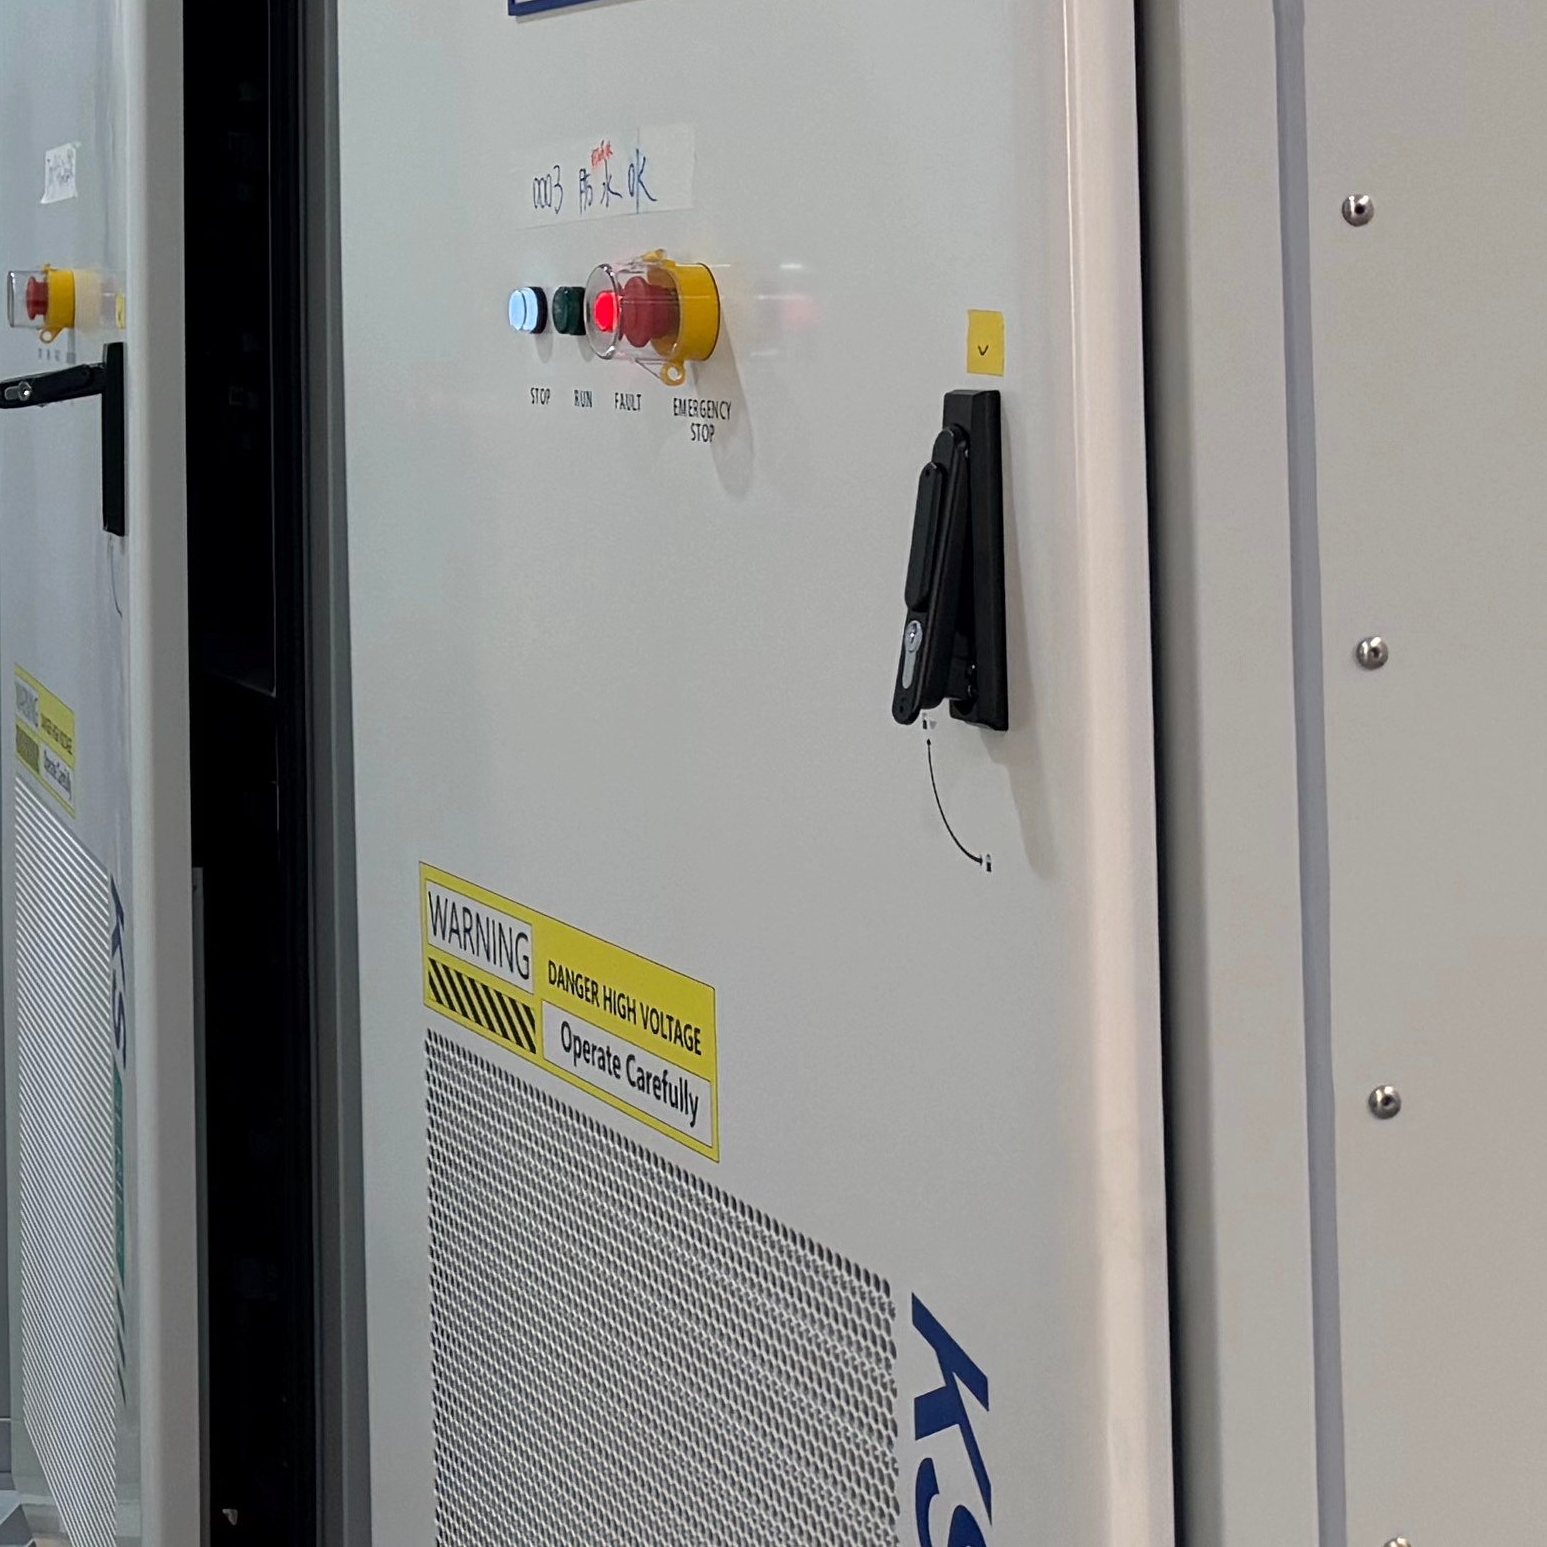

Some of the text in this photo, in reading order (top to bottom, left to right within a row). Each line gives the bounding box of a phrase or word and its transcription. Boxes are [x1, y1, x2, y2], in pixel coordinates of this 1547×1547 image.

[530, 387, 551, 405] STOP
[573, 389, 593, 409] RUN
[614, 392, 642, 411] FAULT
[673, 397, 732, 421] EMERGENCY
[690, 423, 715, 443] STOP
[428, 891, 531, 981] WARNING
[548, 959, 702, 1056] DANGER HIGH VOLTAGE
[560, 1020, 700, 1128] Operate Carefully
